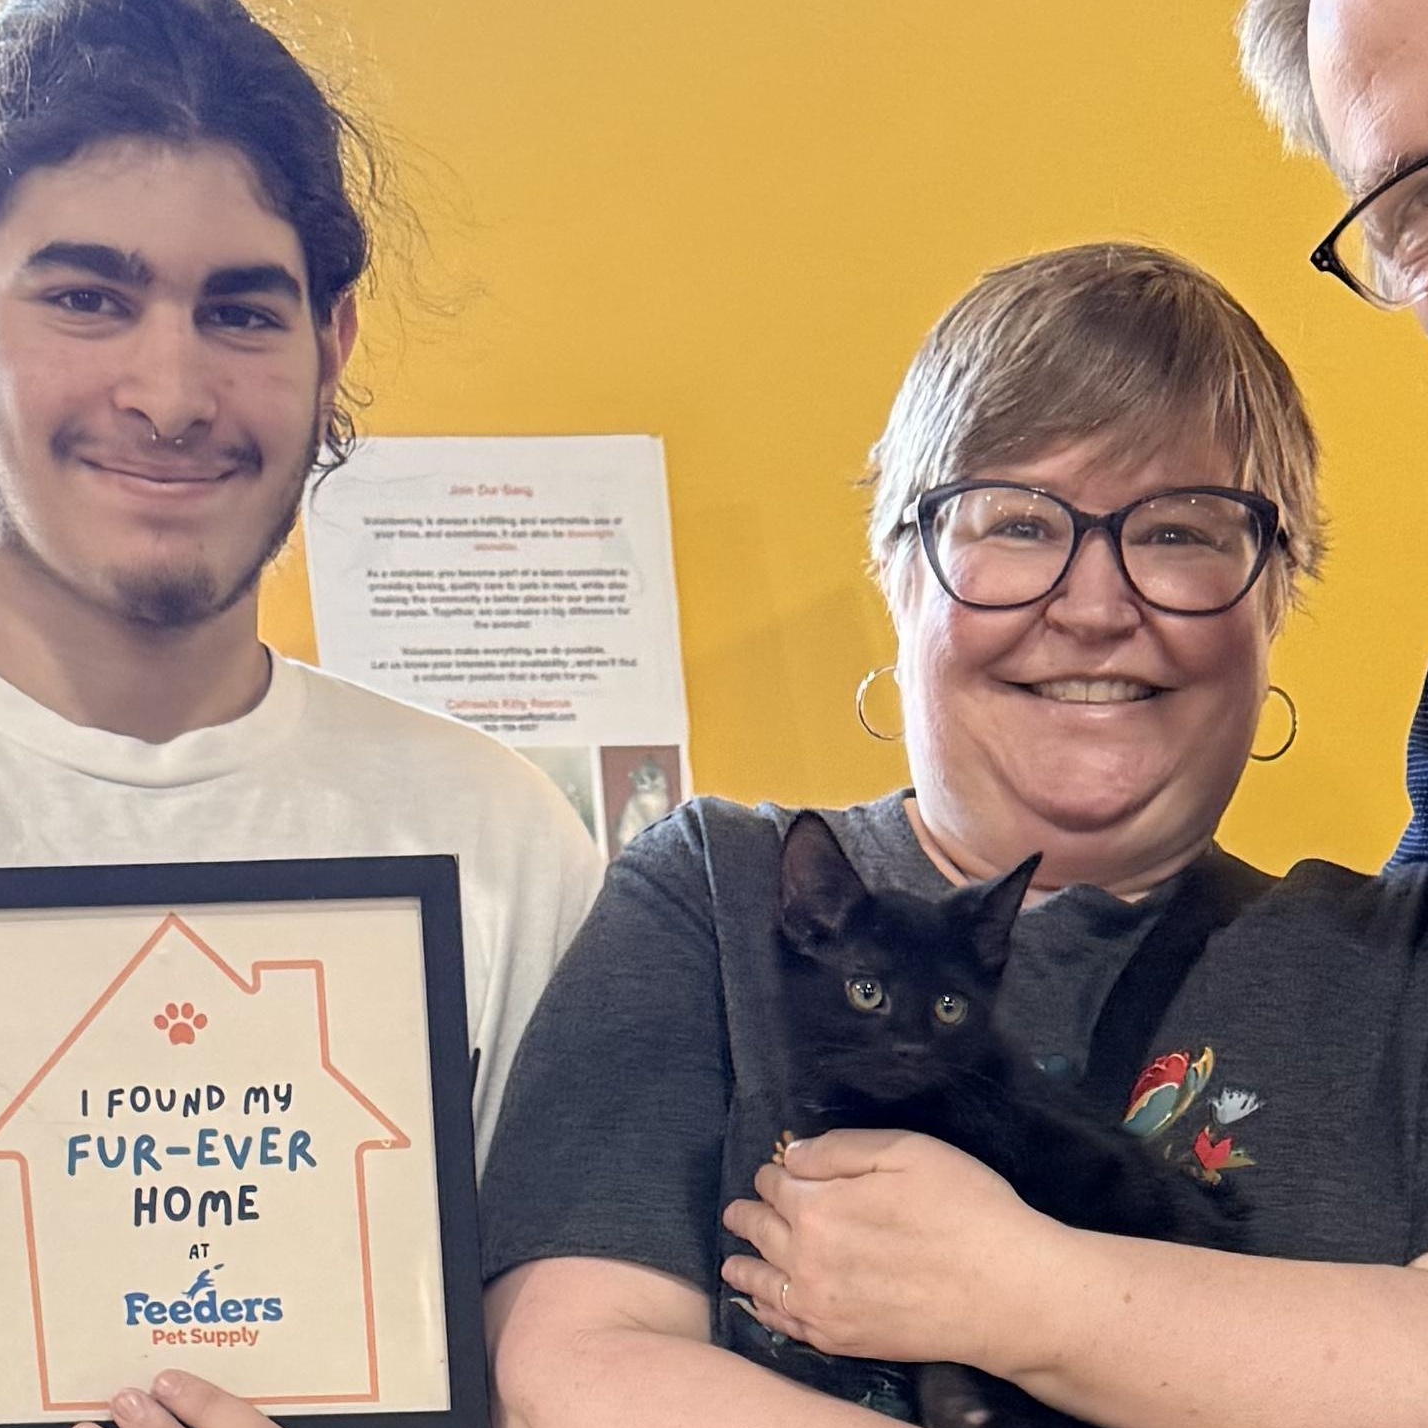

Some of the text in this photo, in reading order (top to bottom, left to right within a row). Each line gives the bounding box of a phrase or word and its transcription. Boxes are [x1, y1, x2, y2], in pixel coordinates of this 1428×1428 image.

[81, 1082, 293, 1119] I FOUND MY
[67, 1126, 317, 1177] FUR-EVER
[133, 1184, 260, 1228] HOME
[188, 1242, 210, 1260] AT
[123, 1289, 284, 1326] Feeders
[152, 1326, 259, 1348] Pet Supply
